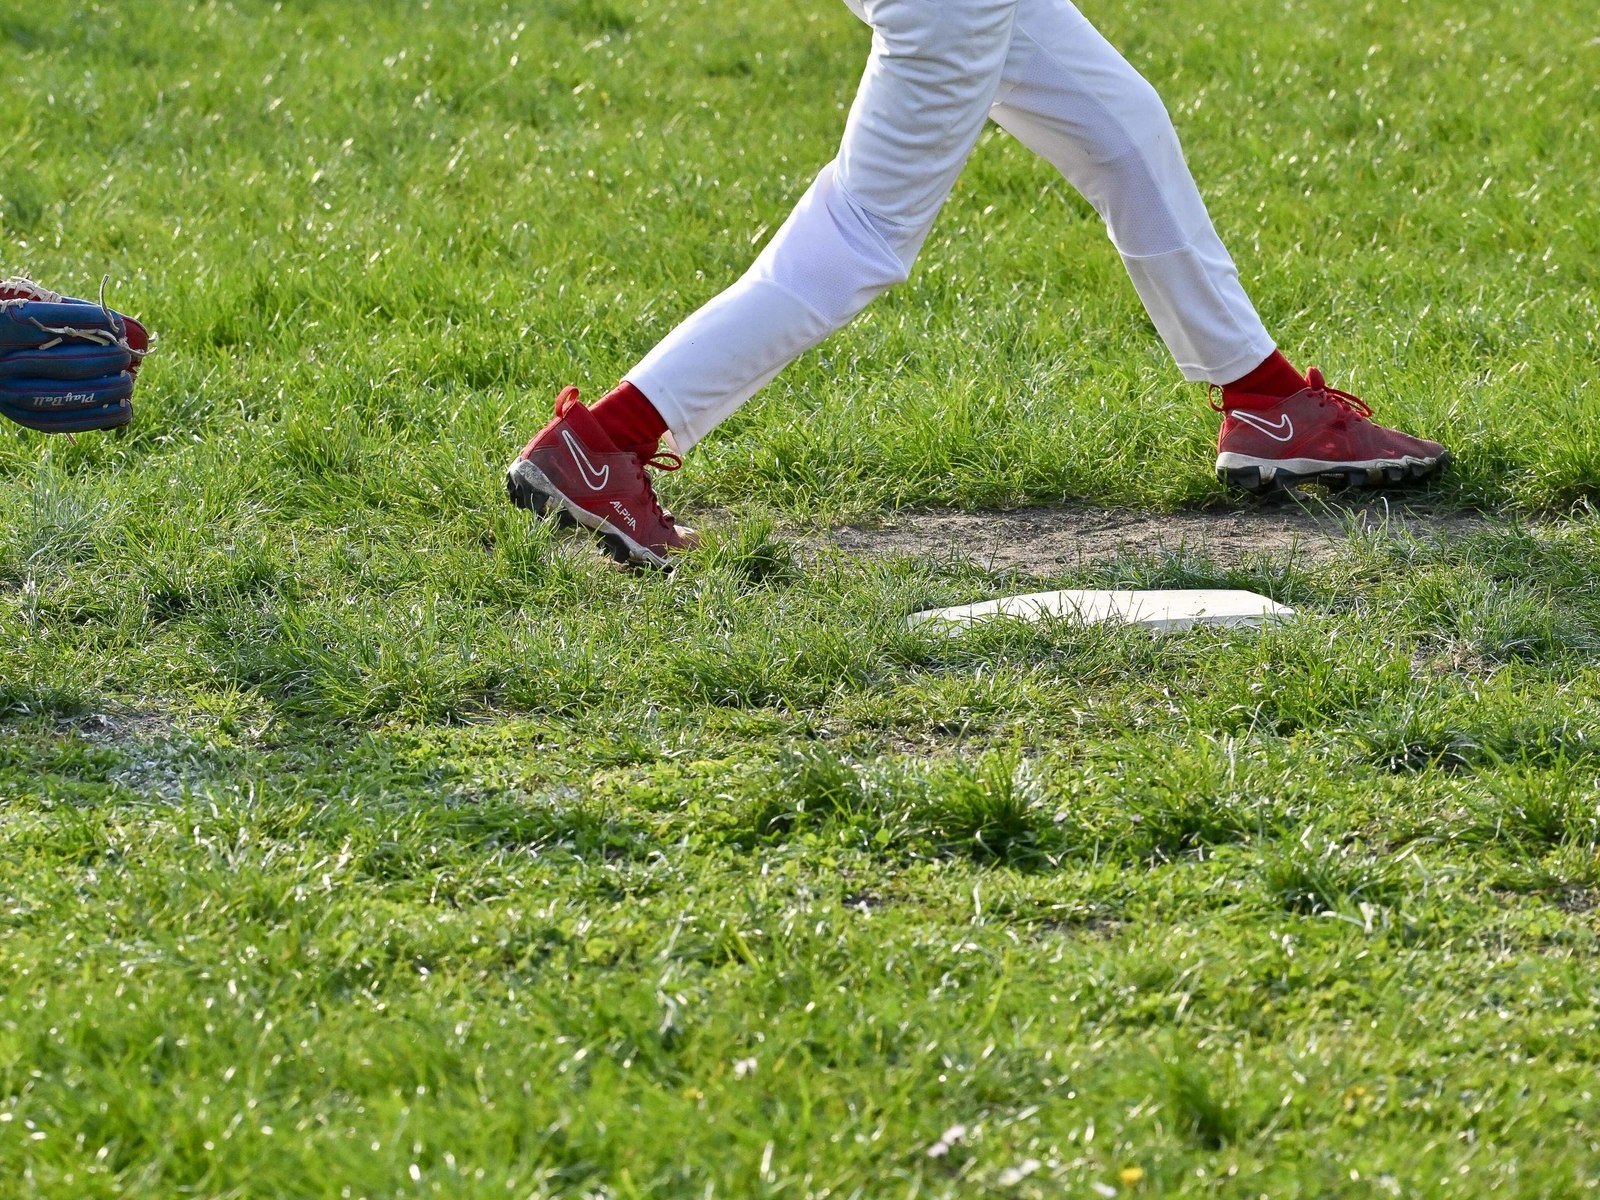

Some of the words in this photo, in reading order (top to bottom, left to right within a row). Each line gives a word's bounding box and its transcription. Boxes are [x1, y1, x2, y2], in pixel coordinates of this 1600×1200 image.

[33, 396, 64, 406] Ball
[64, 392, 97, 404] Play
[609, 501, 636, 532] ALPHA
